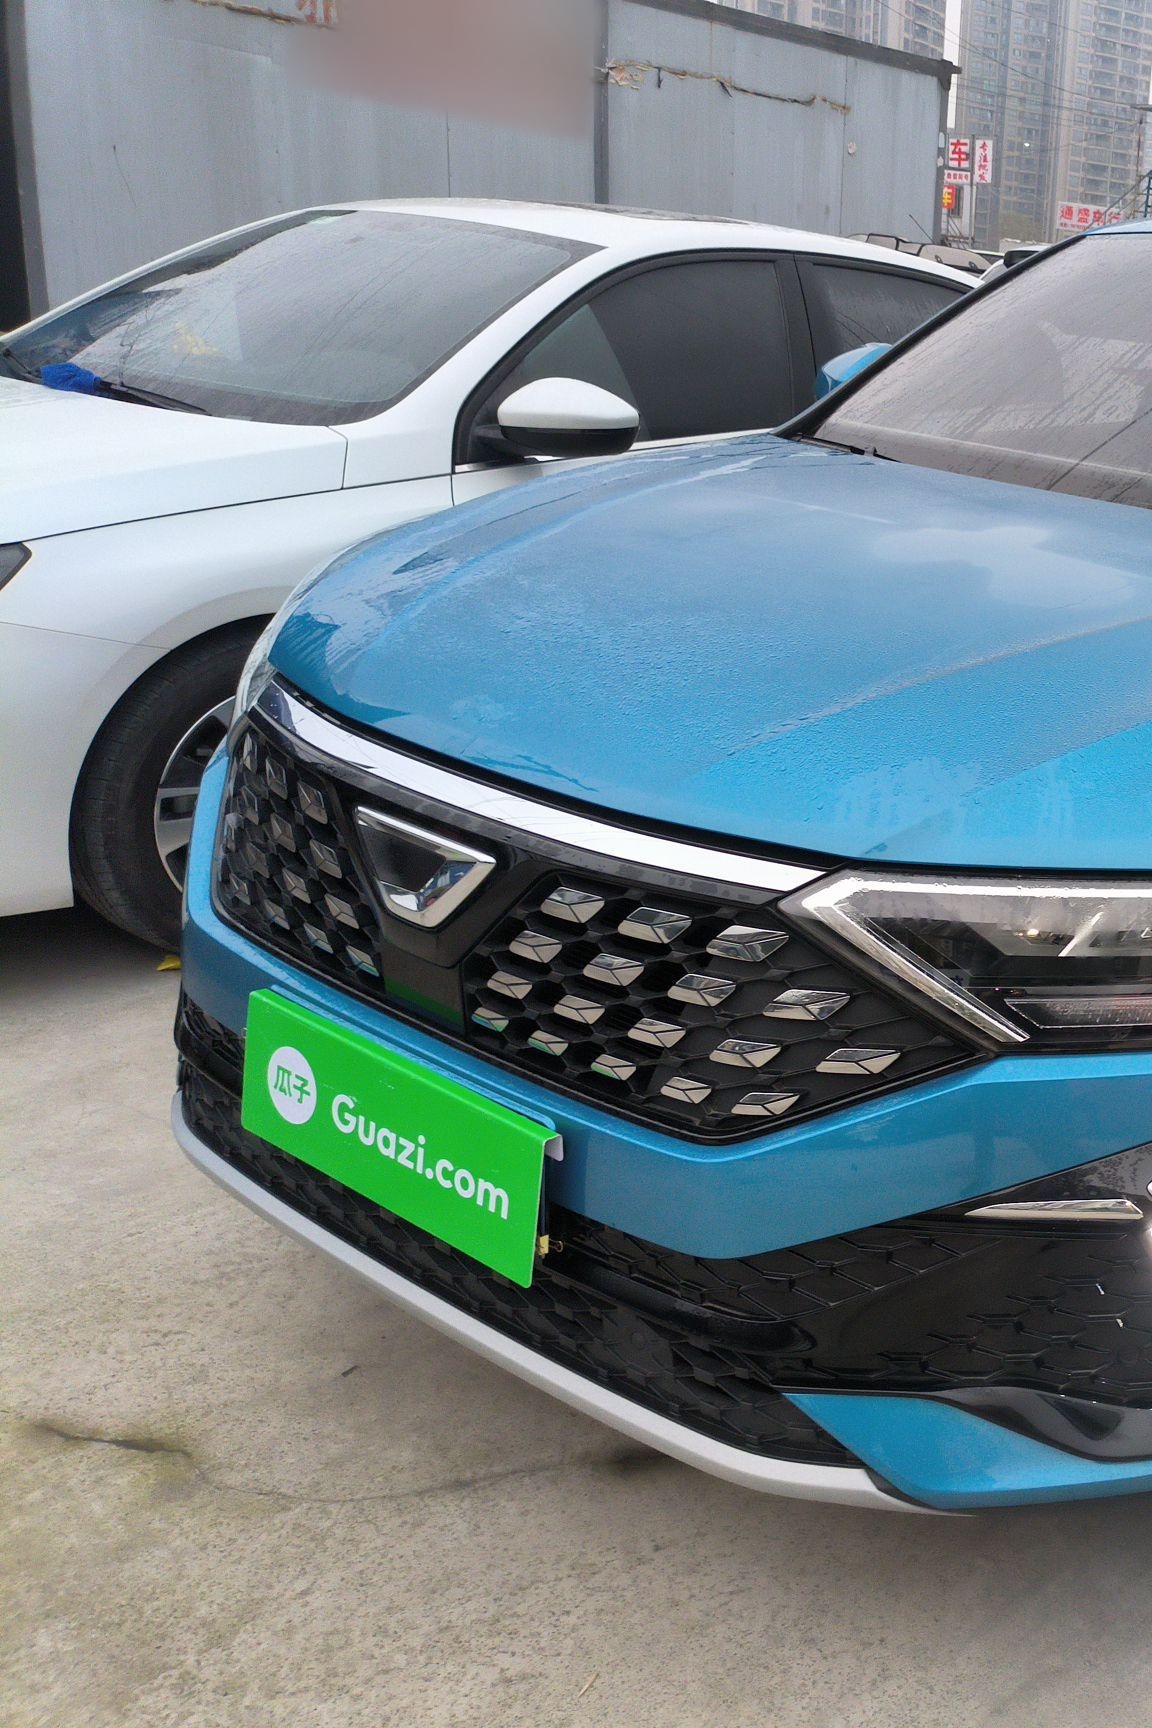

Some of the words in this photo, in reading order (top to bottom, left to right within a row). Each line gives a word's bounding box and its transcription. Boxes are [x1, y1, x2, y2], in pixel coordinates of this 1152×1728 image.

[950, 139, 969, 168] 车
[273, 1064, 311, 1105] 瓜子
[331, 1093, 510, 1220] Guazi.com
